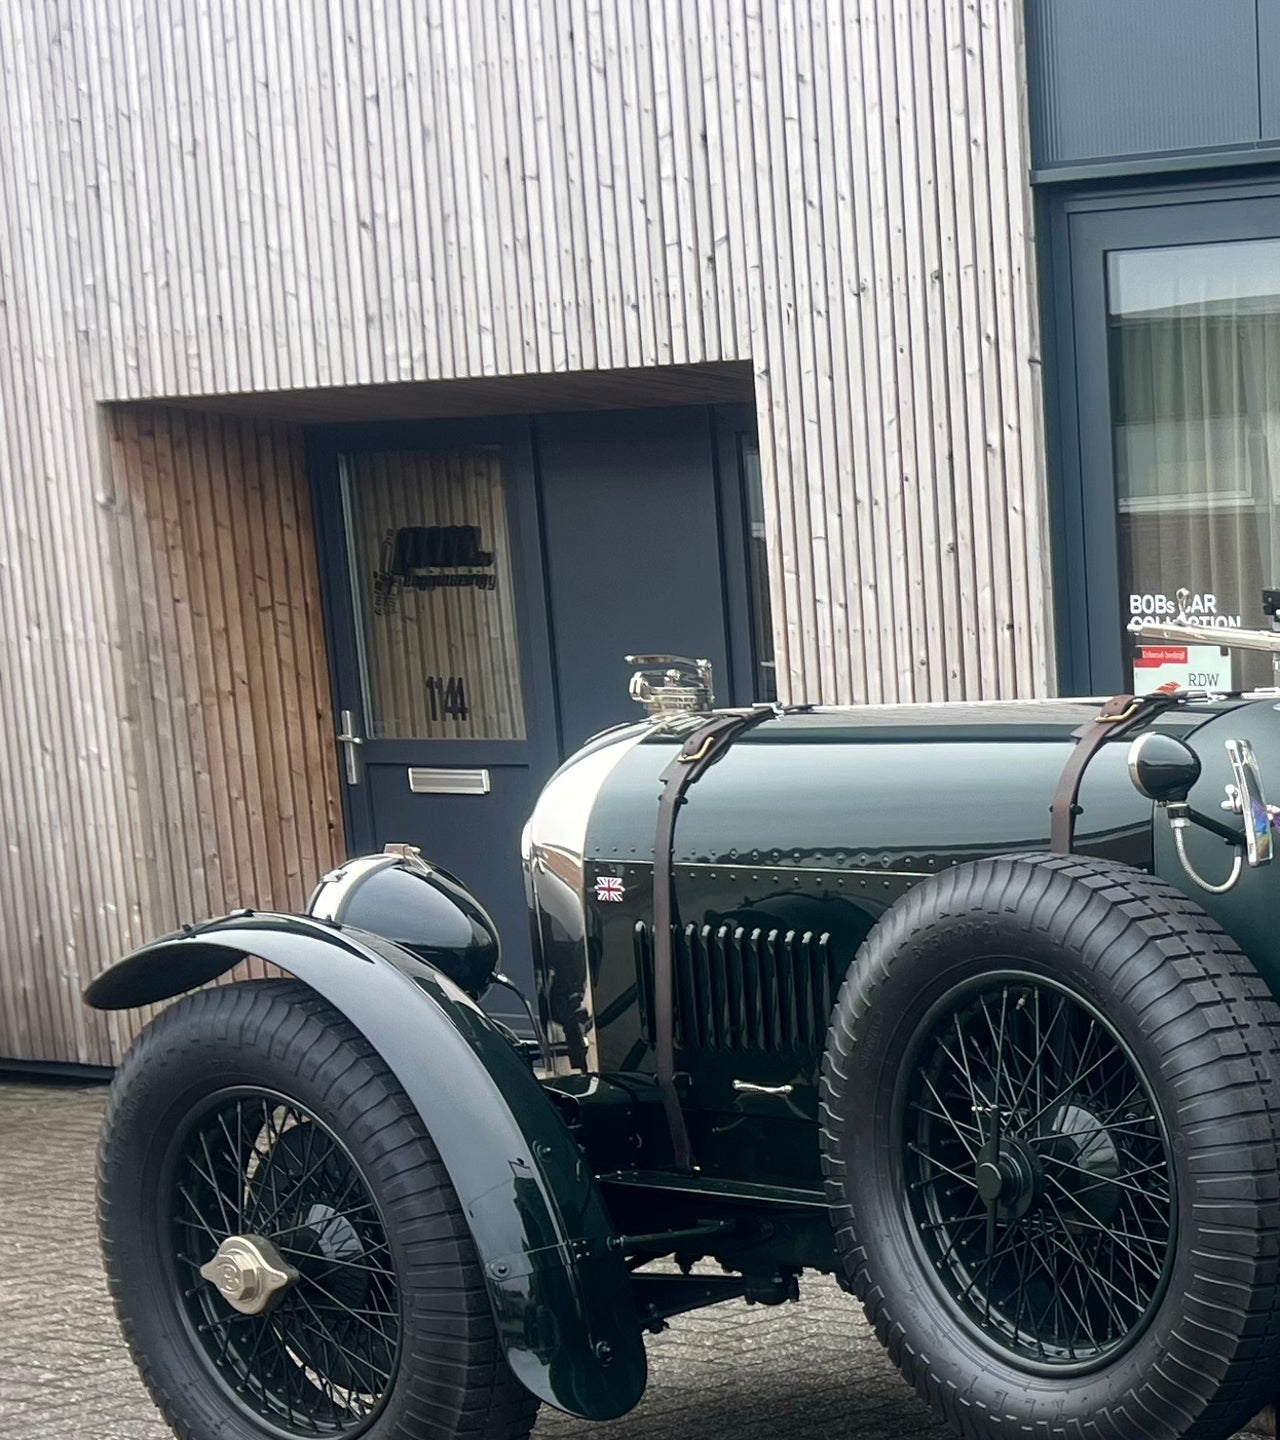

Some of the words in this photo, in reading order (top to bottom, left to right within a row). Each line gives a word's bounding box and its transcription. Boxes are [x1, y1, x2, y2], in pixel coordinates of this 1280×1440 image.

[1129, 594, 1176, 614] BOBs
[1178, 593, 1217, 614] AR
[1187, 672, 1220, 687] RDW
